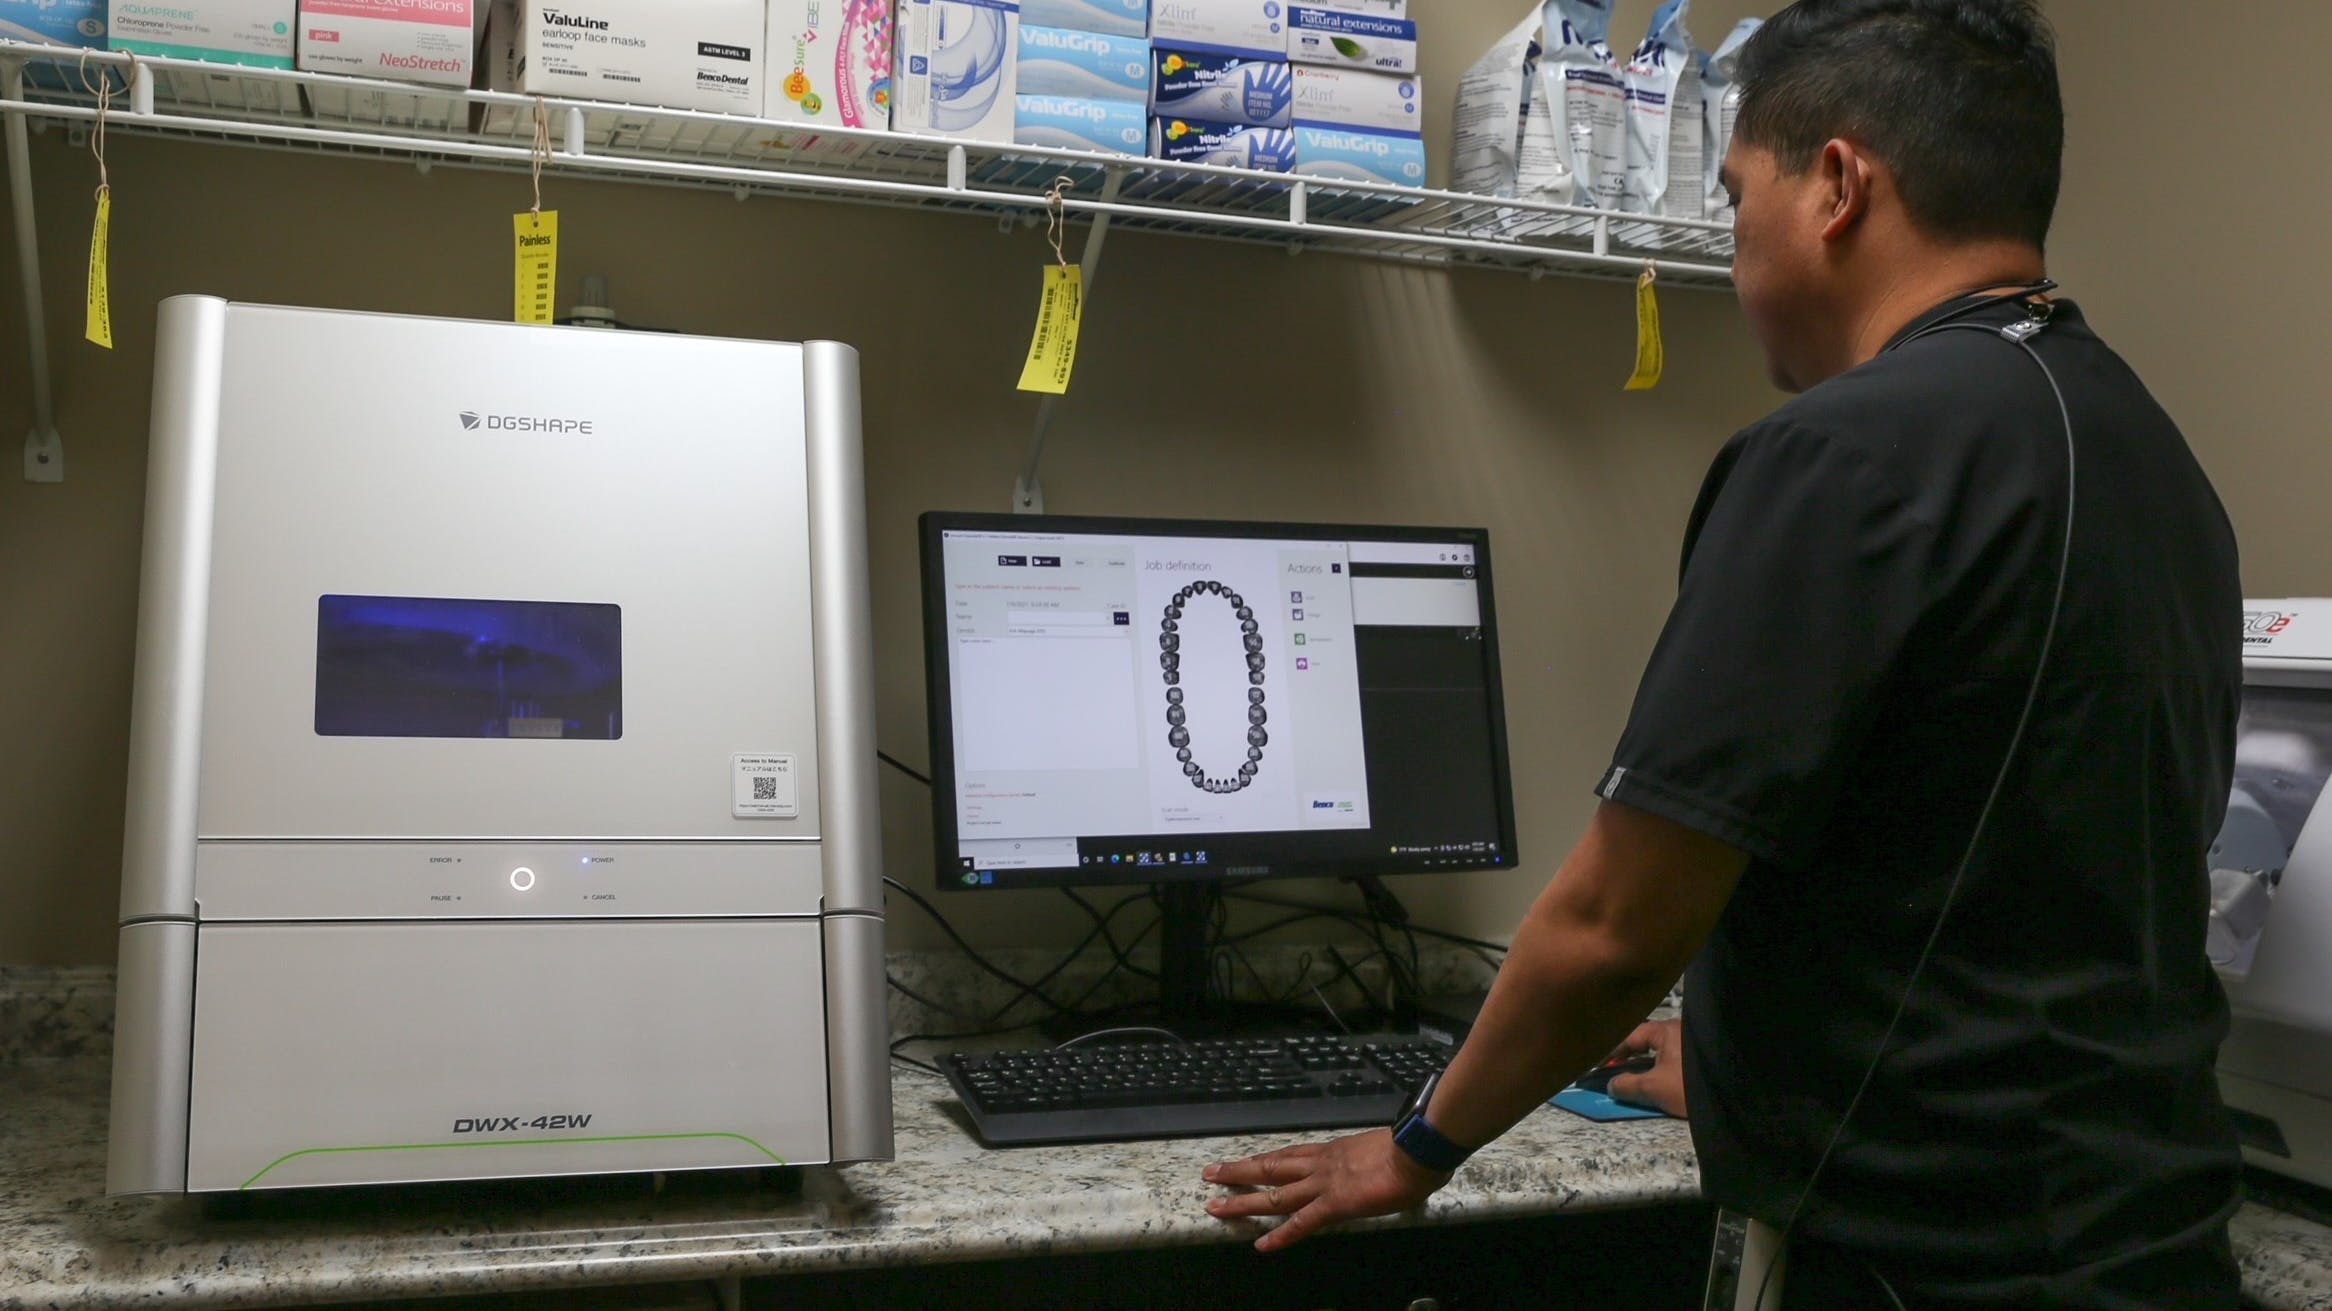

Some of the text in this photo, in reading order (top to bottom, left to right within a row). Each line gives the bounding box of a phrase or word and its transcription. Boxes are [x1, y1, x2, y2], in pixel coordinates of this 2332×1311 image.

[86, 20, 97, 34] S
[117, 16, 164, 29] Chloroprene
[543, 12, 609, 30] ValuLine
[1300, 14, 1340, 26] natural
[1343, 20, 1402, 34] extensions
[315, 32, 332, 41] pink
[543, 28, 646, 48] earloop face masks
[1020, 28, 1110, 56] ValuGrip
[542, 42, 574, 51] SENSITIVE
[704, 46, 720, 54] ASTM
[722, 49, 740, 57] LEVEL
[380, 52, 461, 72] NeoStretch
[1305, 69, 1340, 81] Cranberry
[839, 68, 854, 118] Glamorous
[1017, 97, 1107, 123] ValuGrip
[1305, 131, 1390, 157] ValuGrip
[1408, 165, 1417, 176] M
[520, 234, 551, 247] Painless
[488, 415, 593, 435] DGSHAPE
[1144, 560, 1212, 571] Job definition
[1288, 564, 1323, 574] Actions
[453, 1114, 593, 1134] DWX-42W
